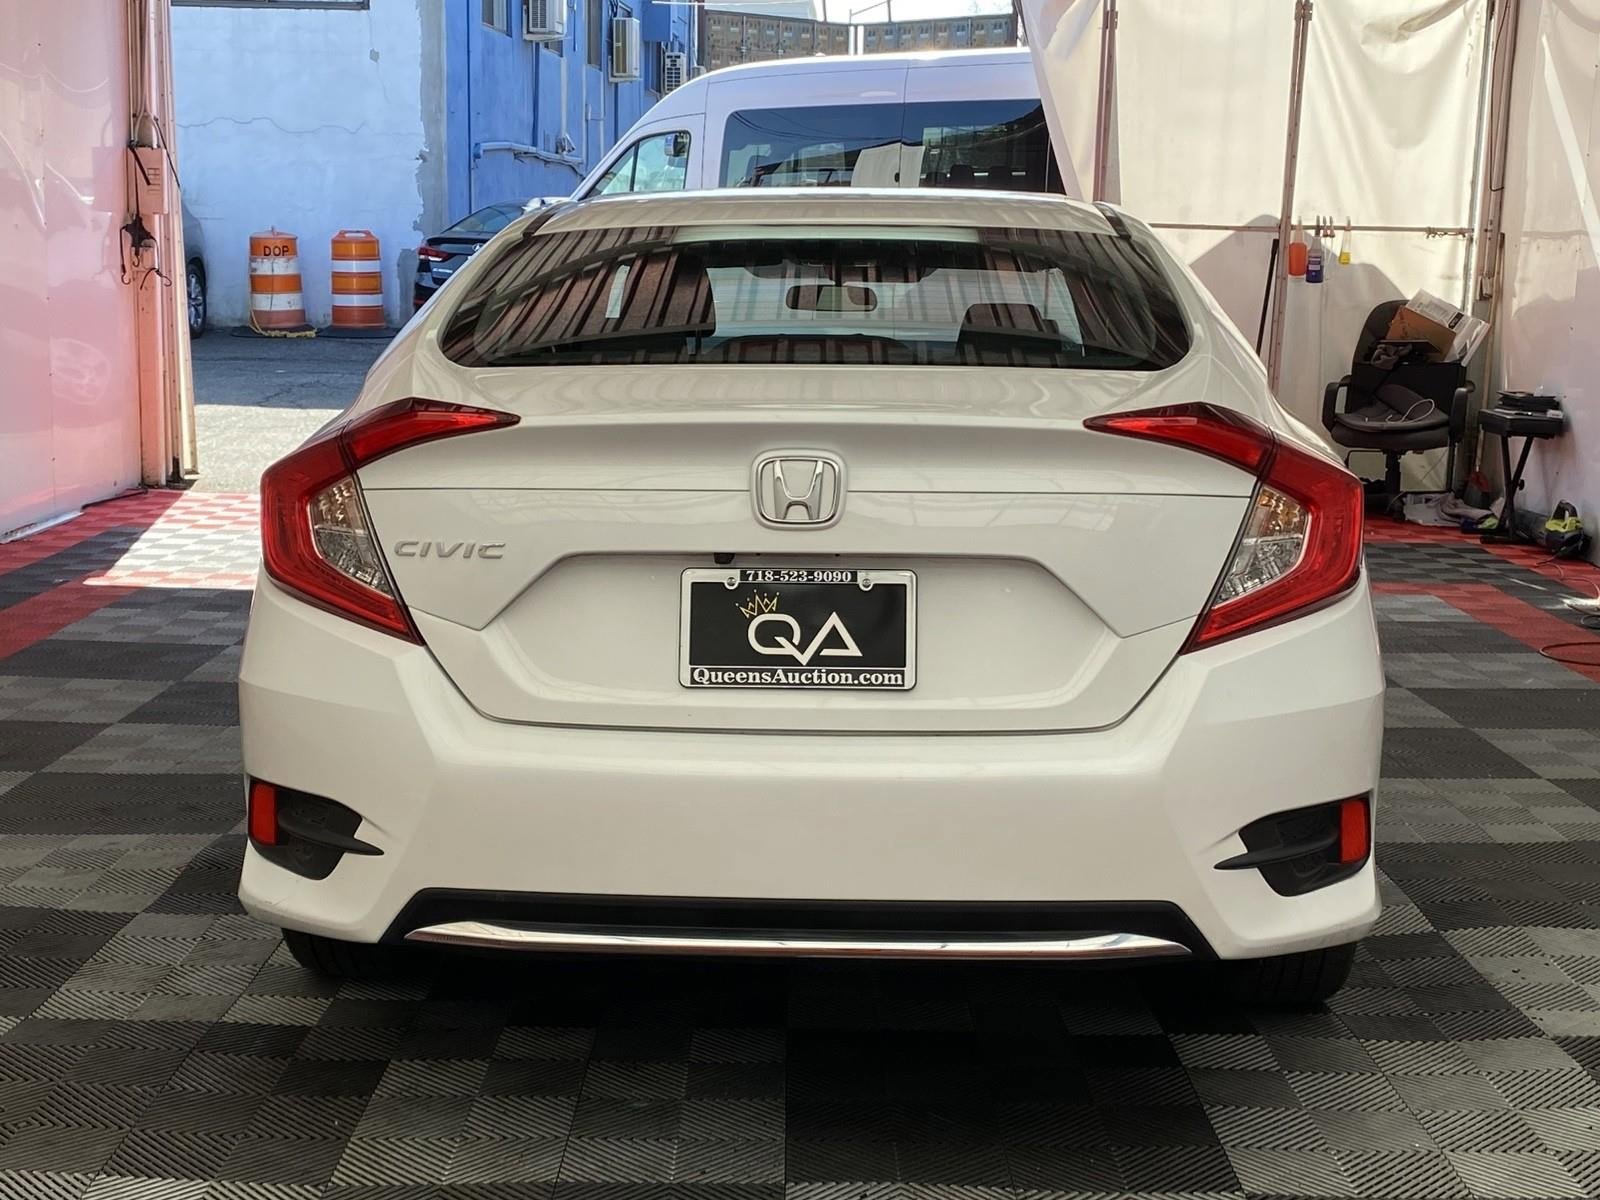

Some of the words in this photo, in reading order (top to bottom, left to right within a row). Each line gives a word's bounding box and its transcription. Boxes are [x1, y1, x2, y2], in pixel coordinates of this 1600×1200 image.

[394, 541, 506, 559] CIVIC
[746, 570, 852, 582] 718-523-9090
[747, 611, 863, 665] QA
[693, 667, 903, 685] QueensAuction.com
